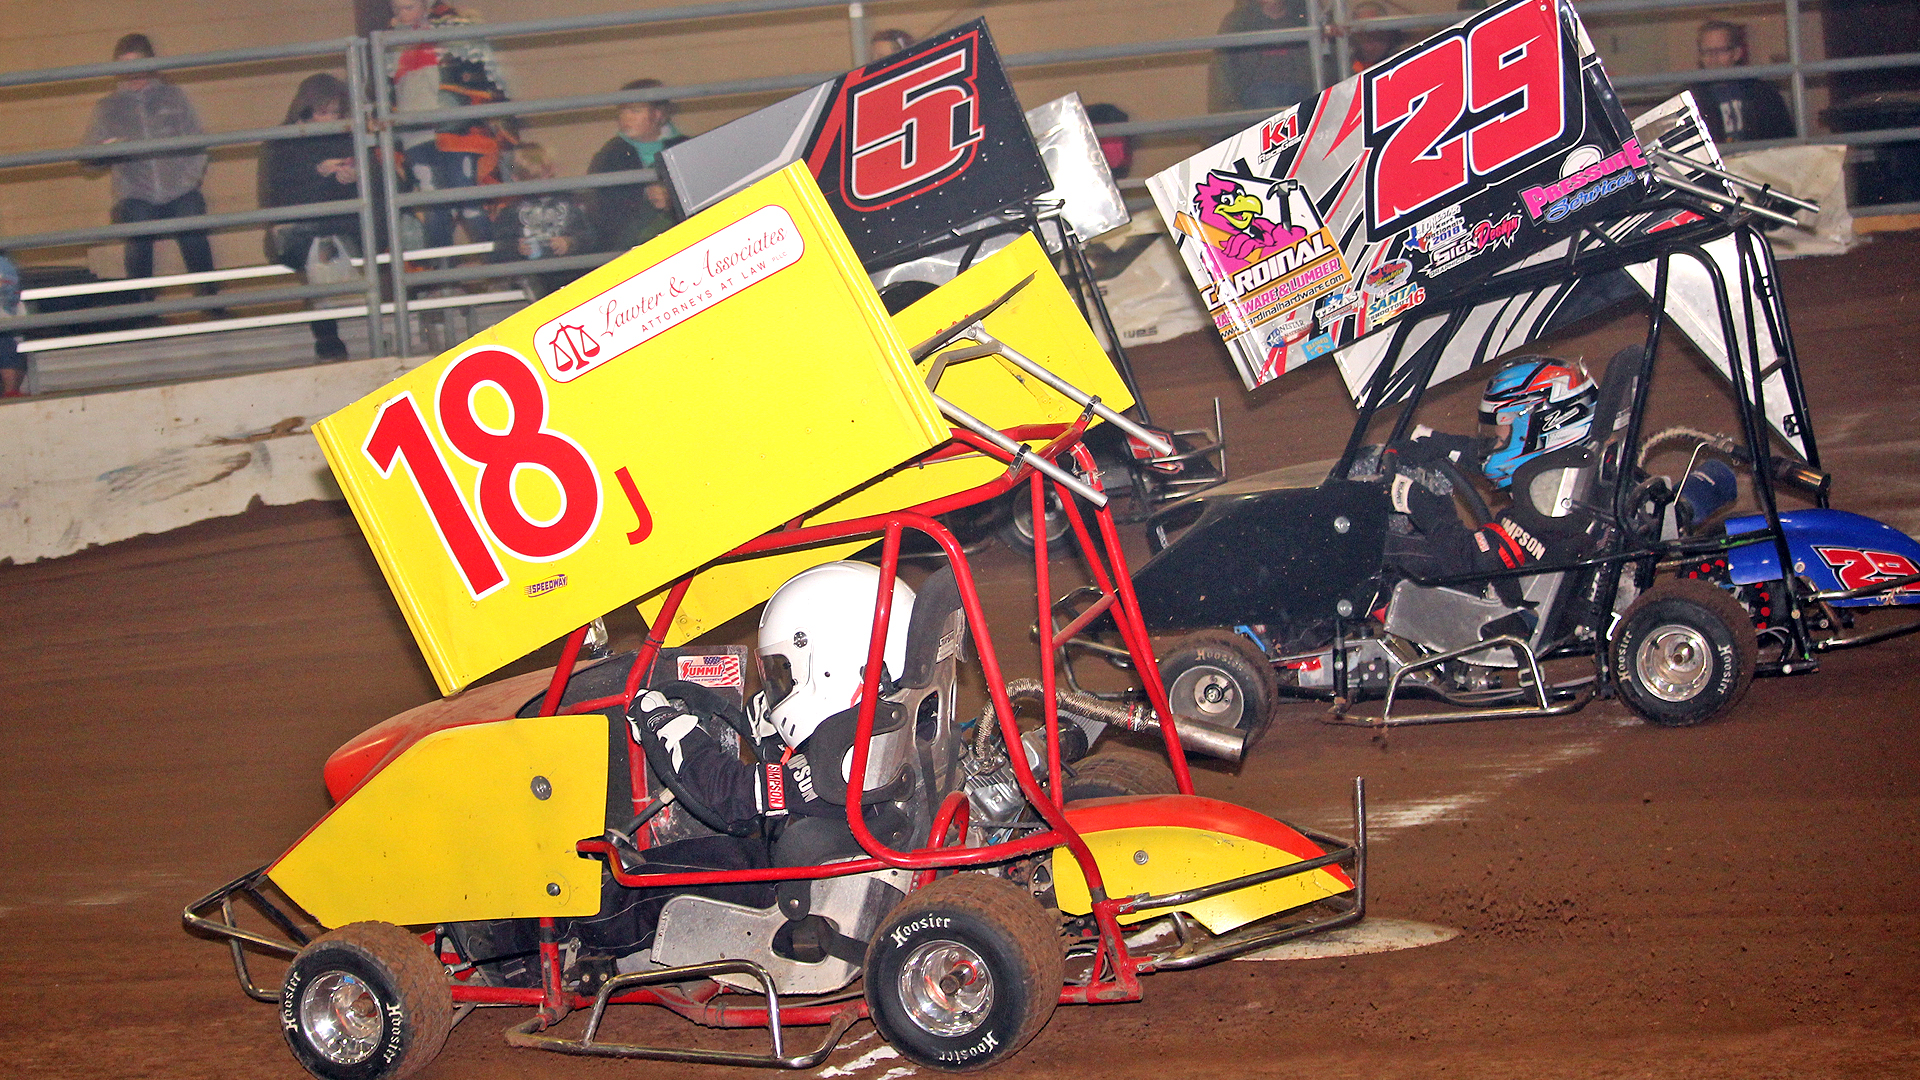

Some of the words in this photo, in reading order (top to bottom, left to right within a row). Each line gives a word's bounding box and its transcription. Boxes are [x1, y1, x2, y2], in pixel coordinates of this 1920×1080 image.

[1261, 114, 1298, 153] K1
[1372, 0, 1565, 230] 29
[1521, 138, 1647, 219] PRESSURE
[1546, 171, 1637, 222] Services
[1432, 226, 1460, 245] 2018
[599, 291, 665, 337] Lawter
[669, 277, 688, 297] &
[693, 227, 787, 286] Associates
[641, 290, 713, 333] ATTORNEYS
[720, 277, 733, 291] AT
[741, 261, 766, 280] LAW
[771, 251, 787, 262] PLLC
[1201, 232, 1334, 311] CARDINAL
[1278, 284, 1291, 298] &
[1290, 257, 1340, 292] LUMBER
[1315, 291, 1360, 318] TEXAS
[1368, 283, 1417, 316] SANTA
[1370, 298, 1409, 320] SHOOTOUT
[1406, 287, 1426, 307] 16
[361, 344, 604, 601] 18
[613, 466, 653, 545] J
[532, 576, 567, 594] SPEEDWAY
[1816, 547, 1920, 595] 29
[682, 662, 723, 679] SUMMIT
[1617, 630, 1633, 683] Hoosier
[1717, 644, 1733, 695] Hoosier
[767, 764, 783, 808] SIMPSON
[890, 913, 951, 949] Hoosier
[283, 971, 301, 1033] Hoosier
[383, 1002, 404, 1064] Hoosier
[938, 1030, 999, 1065] Hoosier
